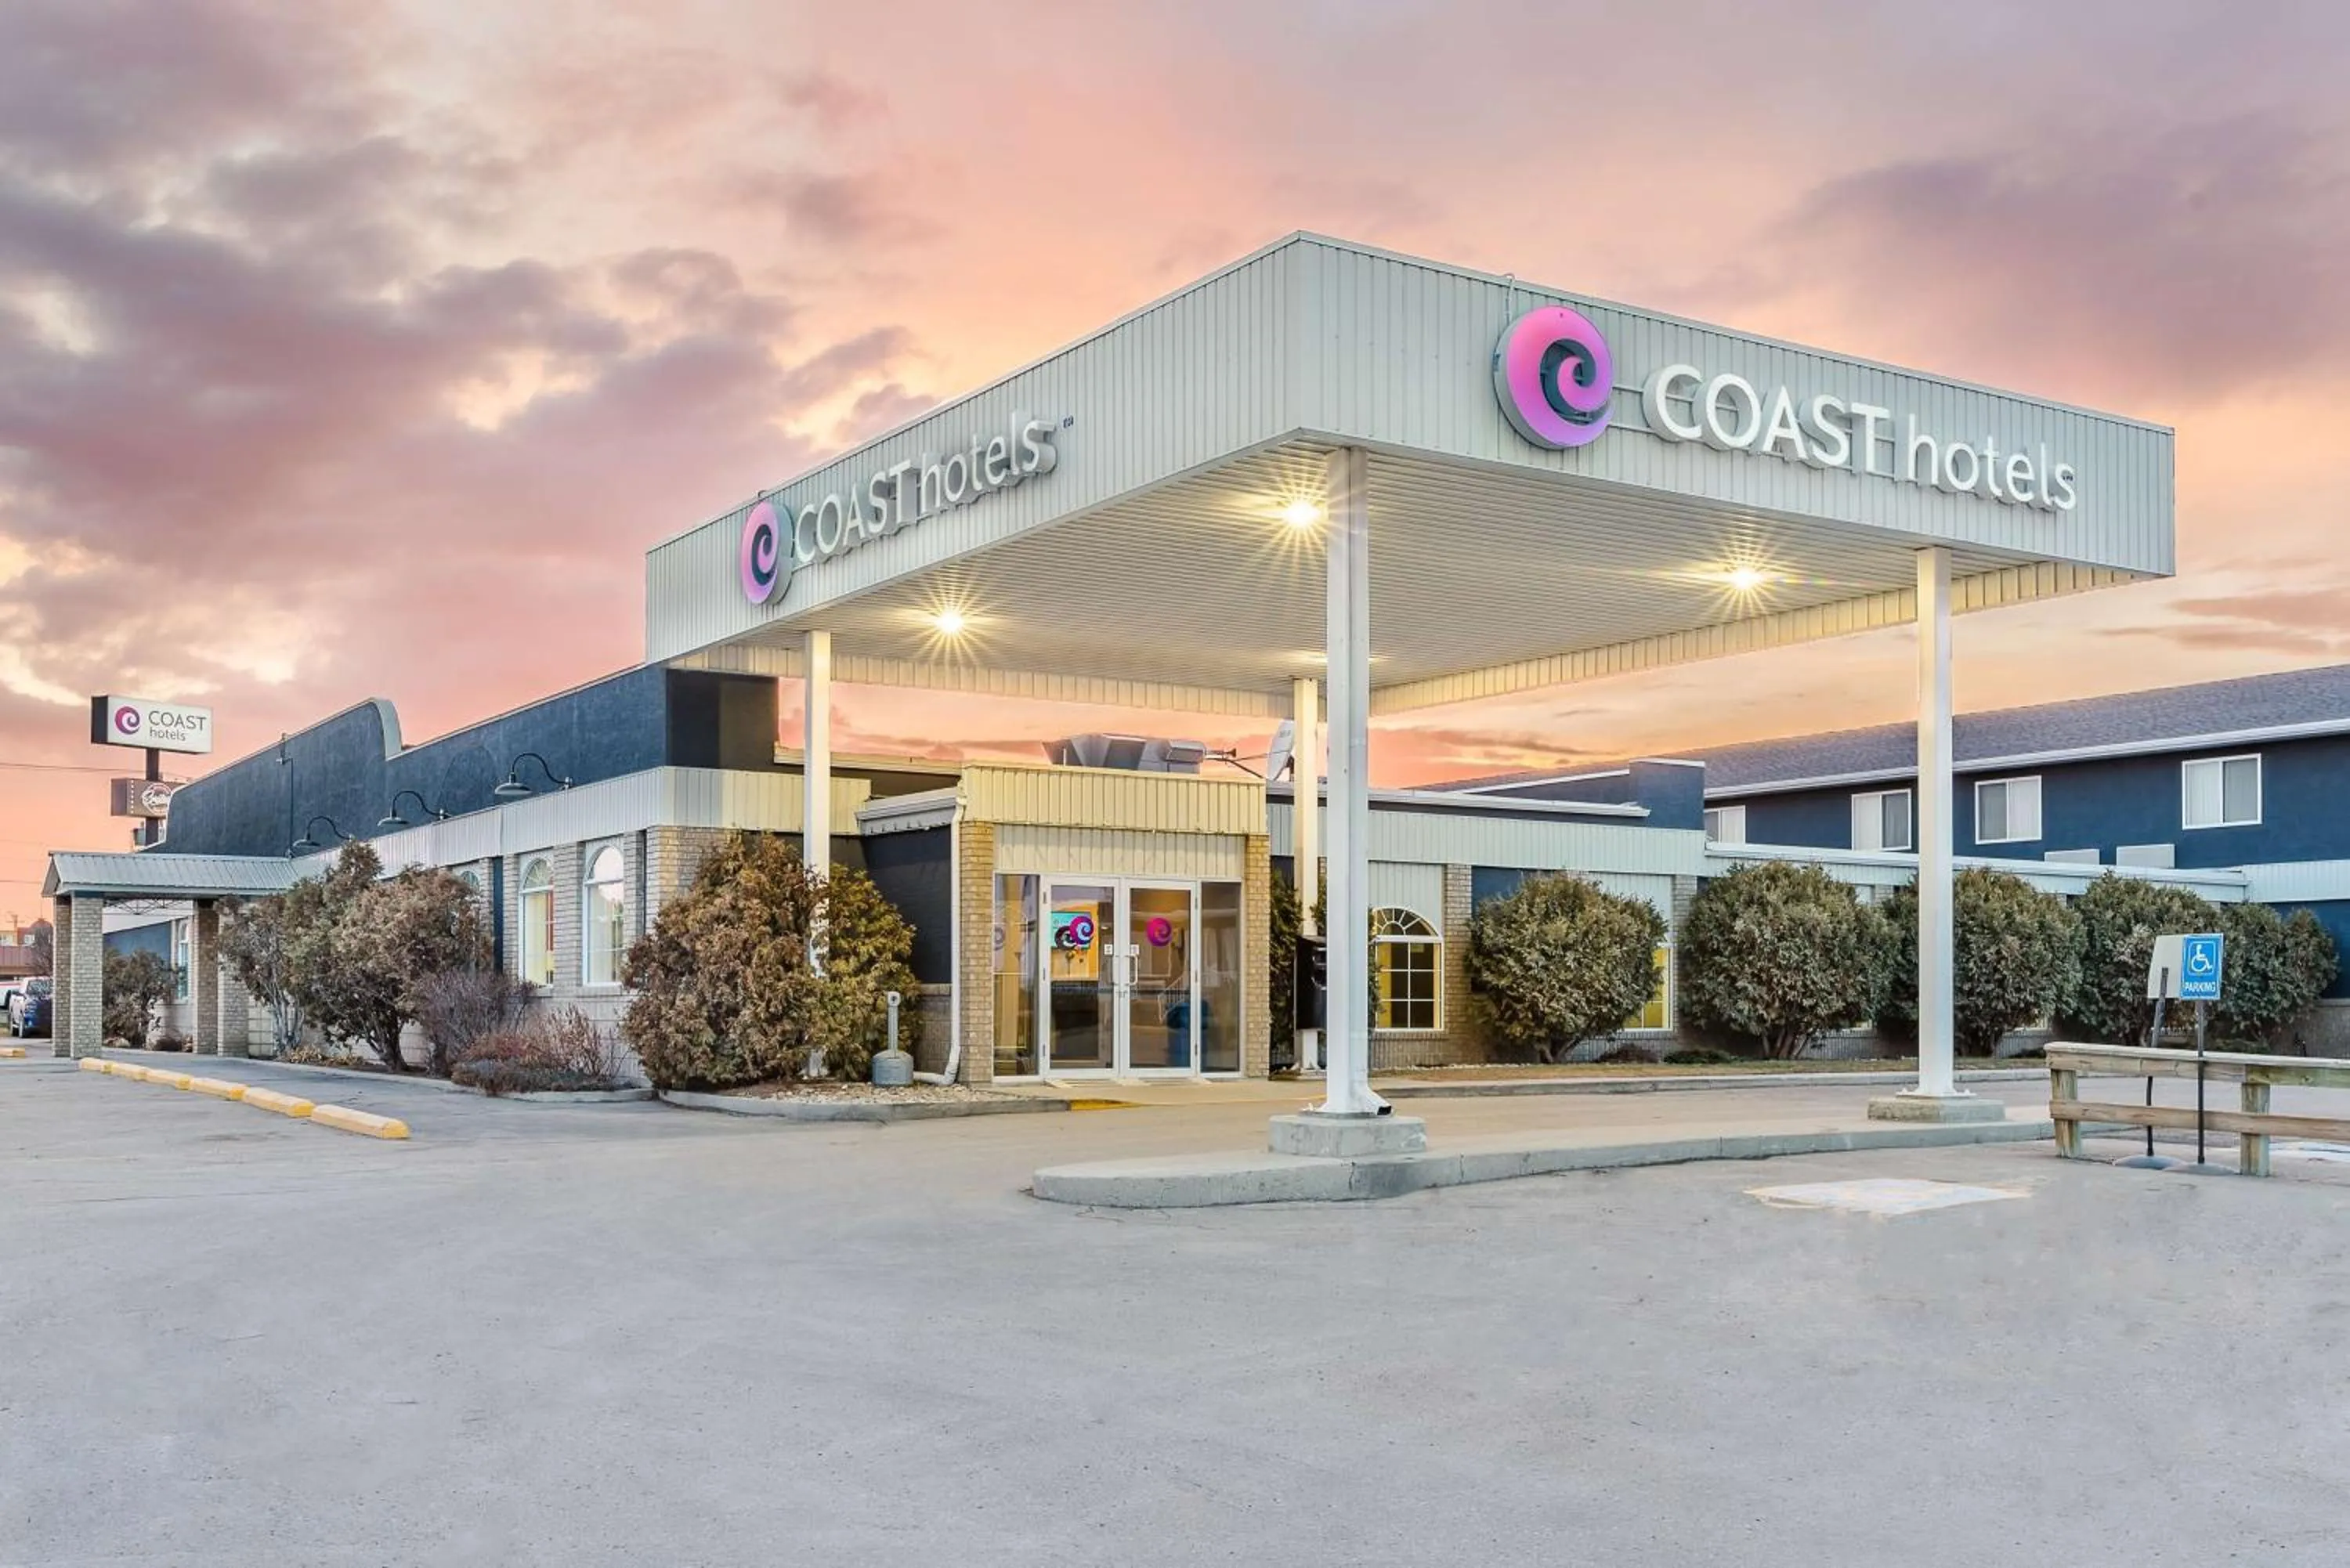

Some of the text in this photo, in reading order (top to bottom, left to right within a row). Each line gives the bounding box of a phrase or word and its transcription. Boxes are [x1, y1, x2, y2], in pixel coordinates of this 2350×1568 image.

[1653, 363, 2076, 511] COAST hotels
[795, 410, 1043, 563] COAST hotels
[148, 710, 207, 731] COAST
[150, 726, 186, 741] hotels
[2184, 981, 2216, 992] PARKING
